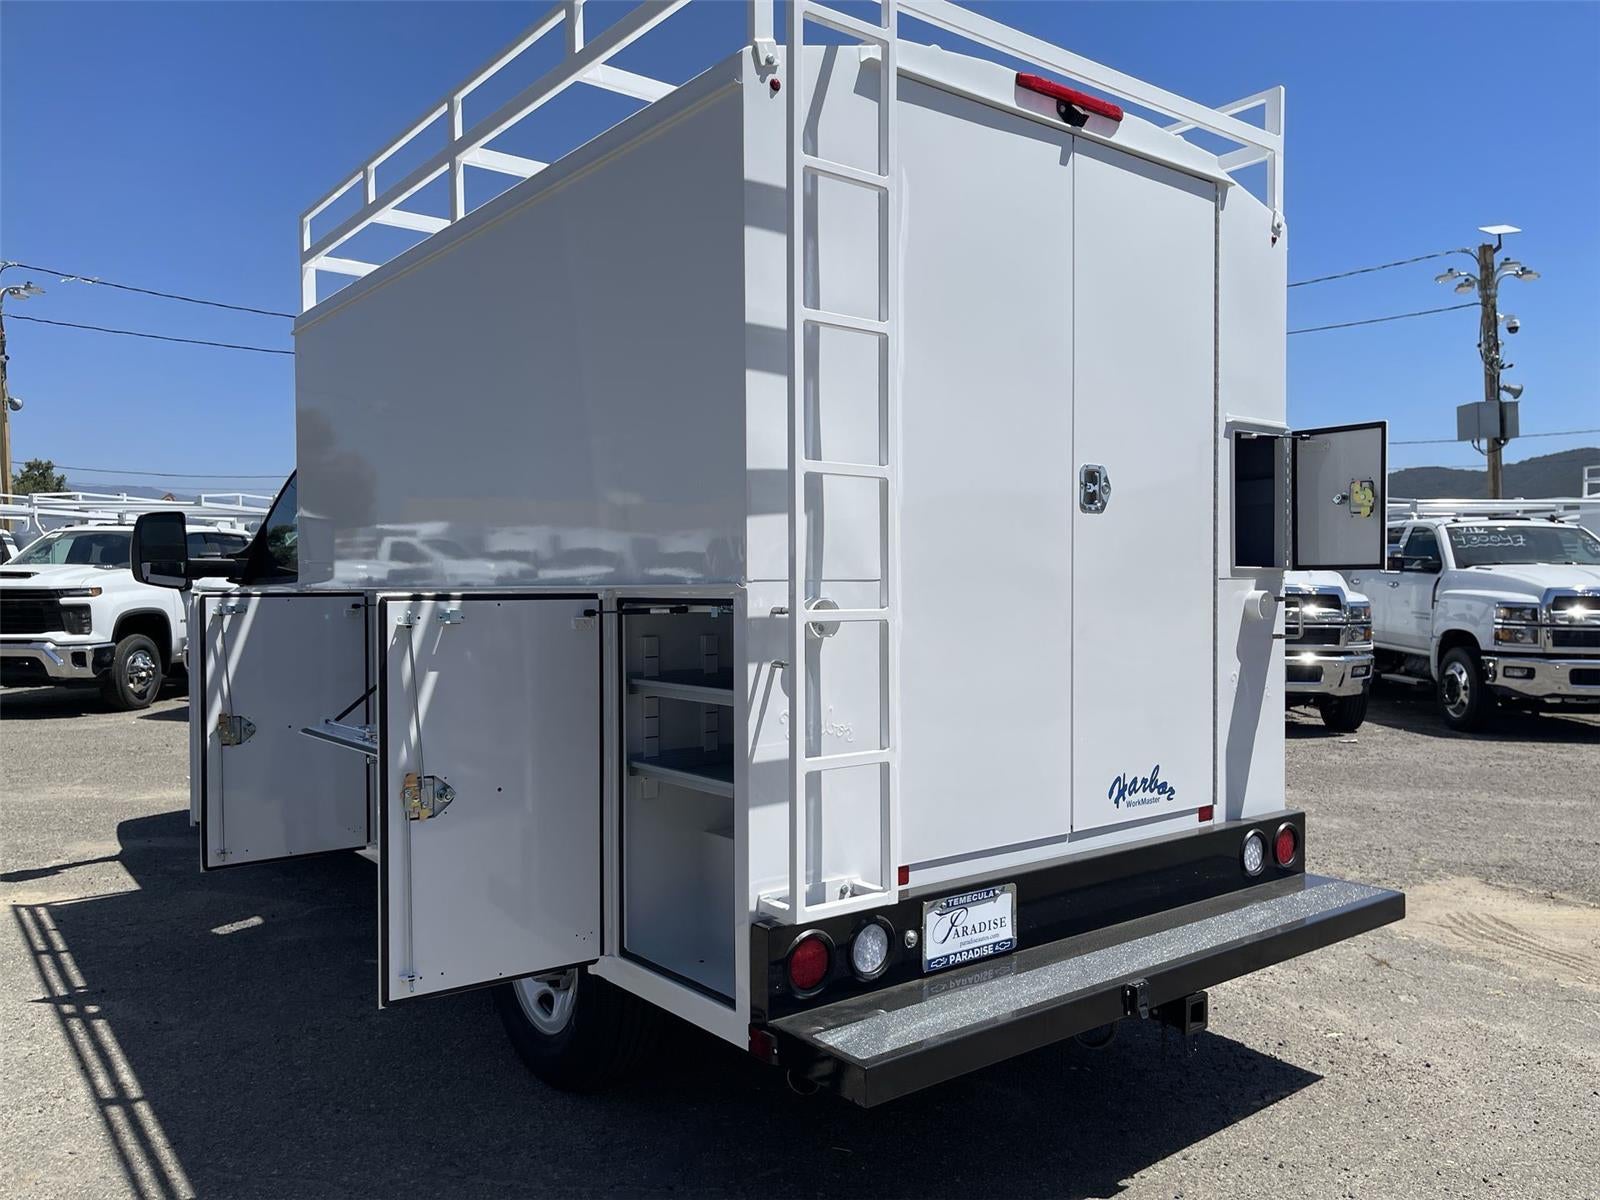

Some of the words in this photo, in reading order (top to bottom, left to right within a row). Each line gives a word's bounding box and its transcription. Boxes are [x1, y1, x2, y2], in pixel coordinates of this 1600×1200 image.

[1108, 764, 1176, 809] Harbor
[1125, 797, 1161, 809] WorkMaster
[947, 890, 994, 907] TEMECULA
[932, 906, 1007, 944] PARADISE
[949, 944, 994, 964] PARADISE
